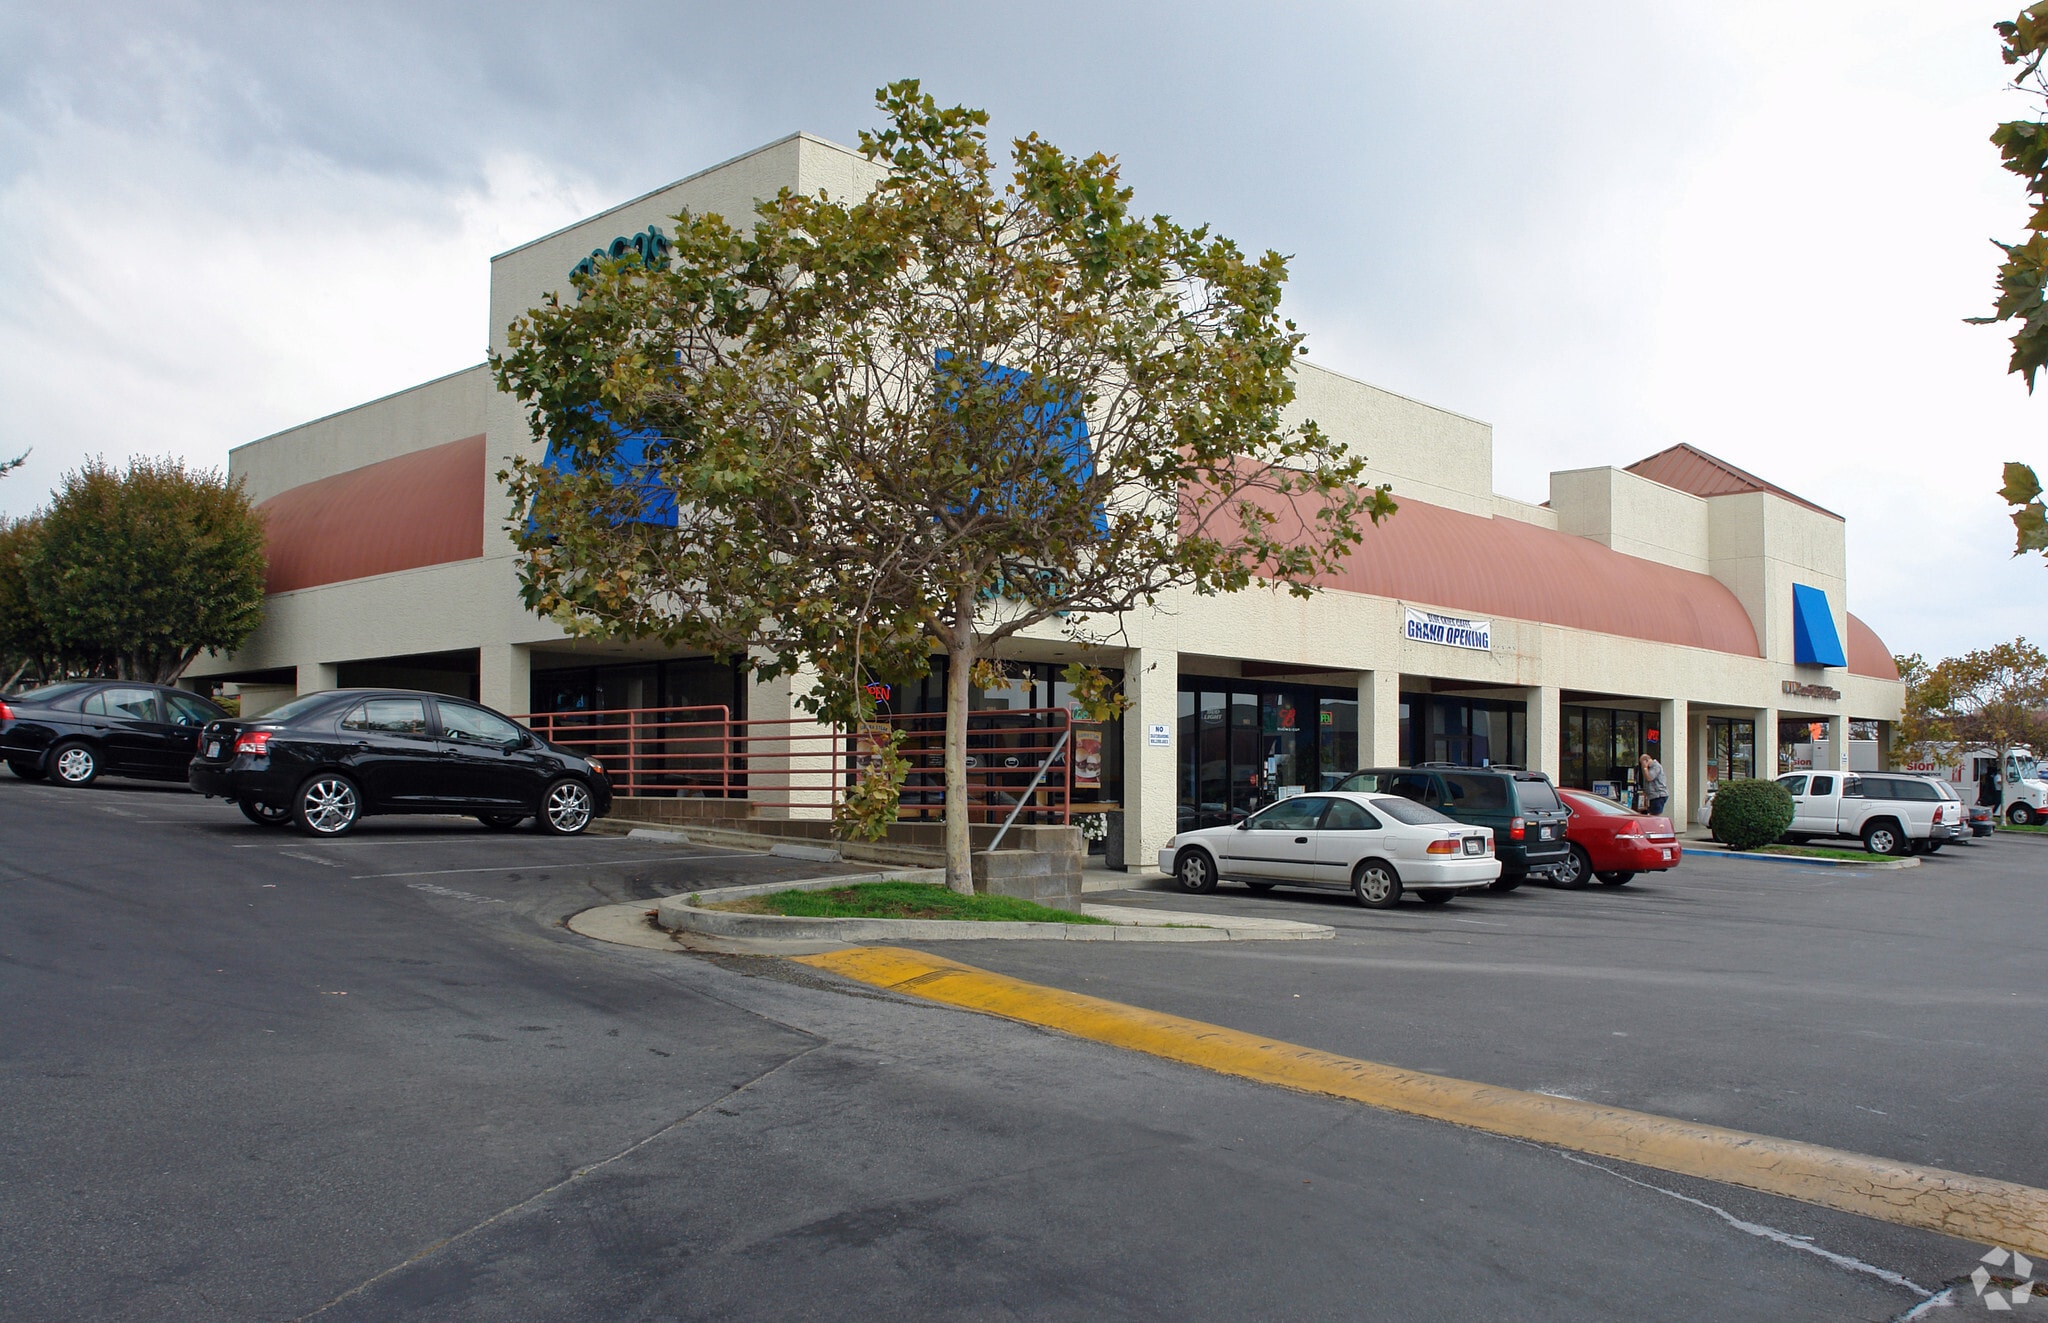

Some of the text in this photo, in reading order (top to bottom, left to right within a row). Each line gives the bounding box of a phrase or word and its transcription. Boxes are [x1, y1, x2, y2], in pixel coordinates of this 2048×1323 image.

[1408, 620, 1488, 648] GRAND OPENING
[864, 685, 890, 700] PEN
[1793, 758, 1812, 766] sion
[1906, 761, 1935, 771] sion
